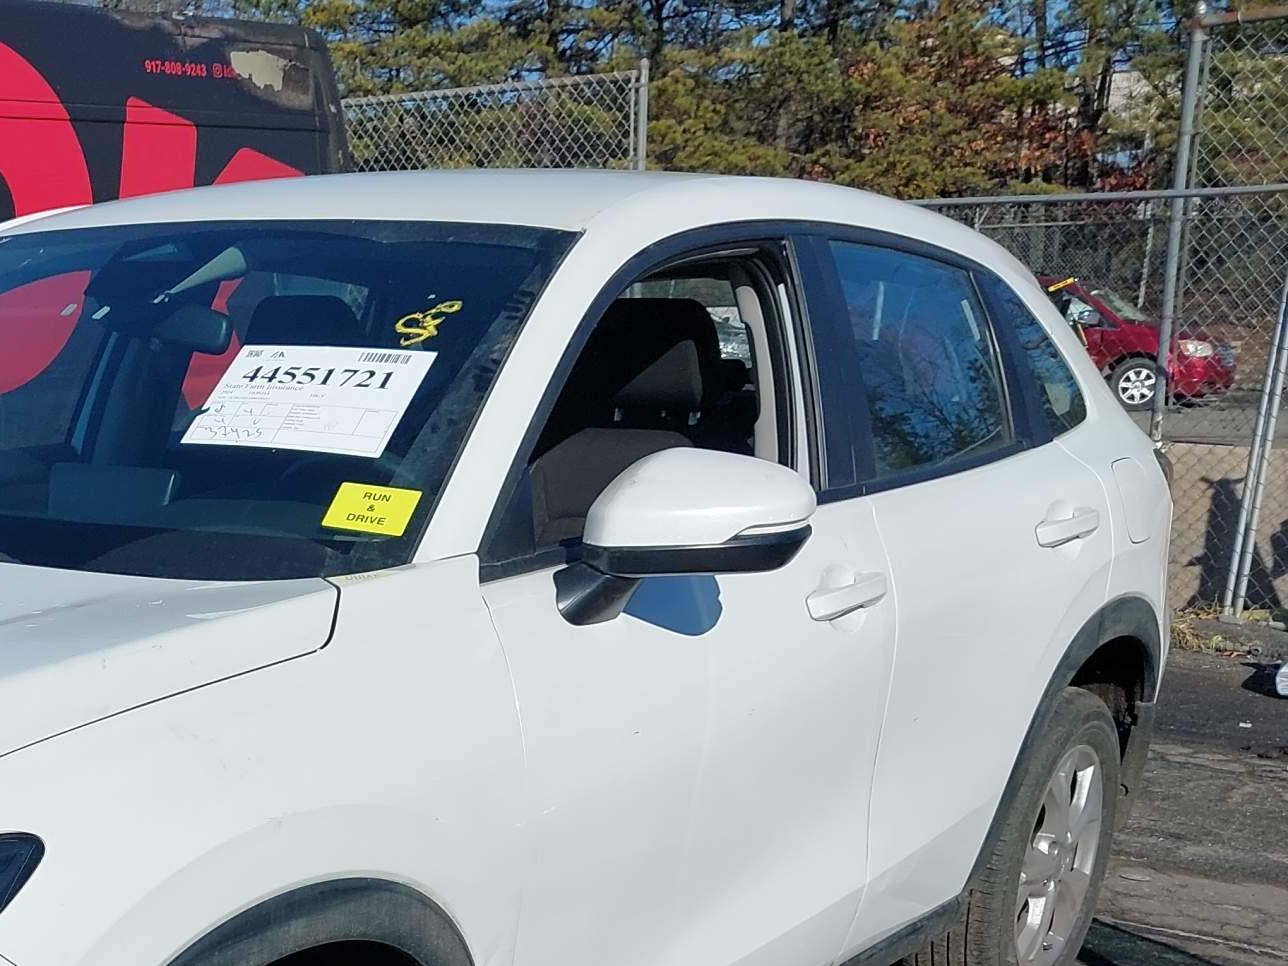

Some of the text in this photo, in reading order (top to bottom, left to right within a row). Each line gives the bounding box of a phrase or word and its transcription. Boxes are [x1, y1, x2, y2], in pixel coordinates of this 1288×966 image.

[144, 60, 207, 76] 917-808-9243
[242, 366, 395, 390] 44551721
[362, 491, 393, 503] RUN
[366, 504, 376, 512] &
[345, 512, 387, 526] DRIVE
